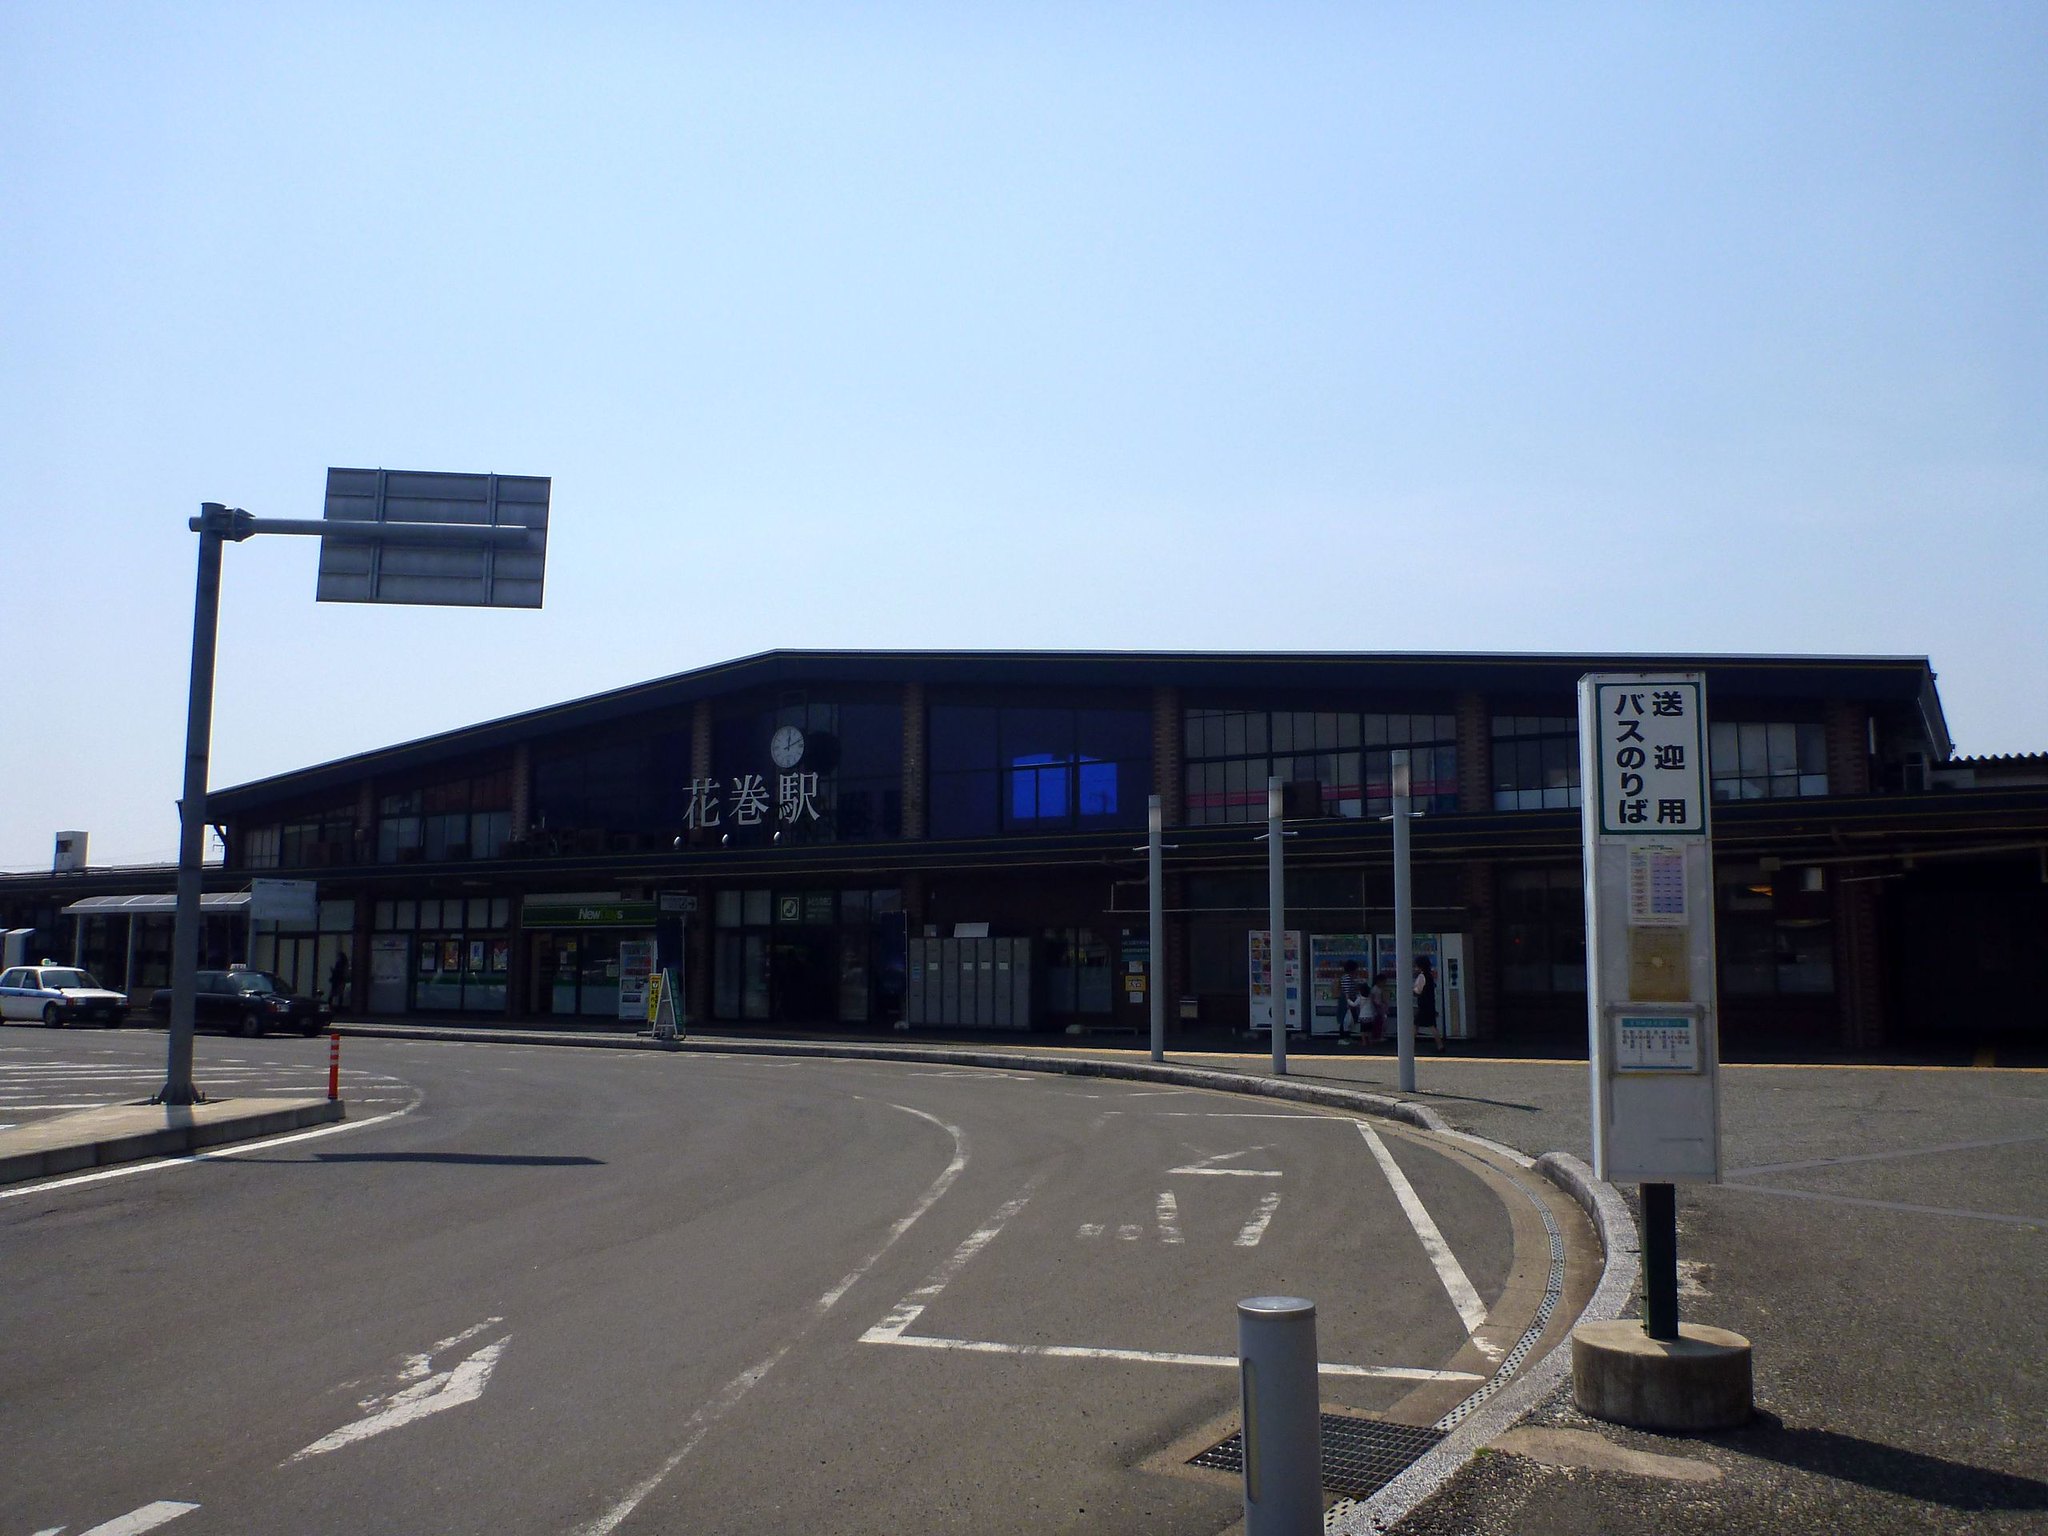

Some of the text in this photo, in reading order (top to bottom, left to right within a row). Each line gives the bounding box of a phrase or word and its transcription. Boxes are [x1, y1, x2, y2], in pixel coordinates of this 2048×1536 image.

[682, 772, 820, 830] 花巻駅
[1614, 694, 1649, 824] バスのりば
[1653, 691, 1687, 824] 送迎用
